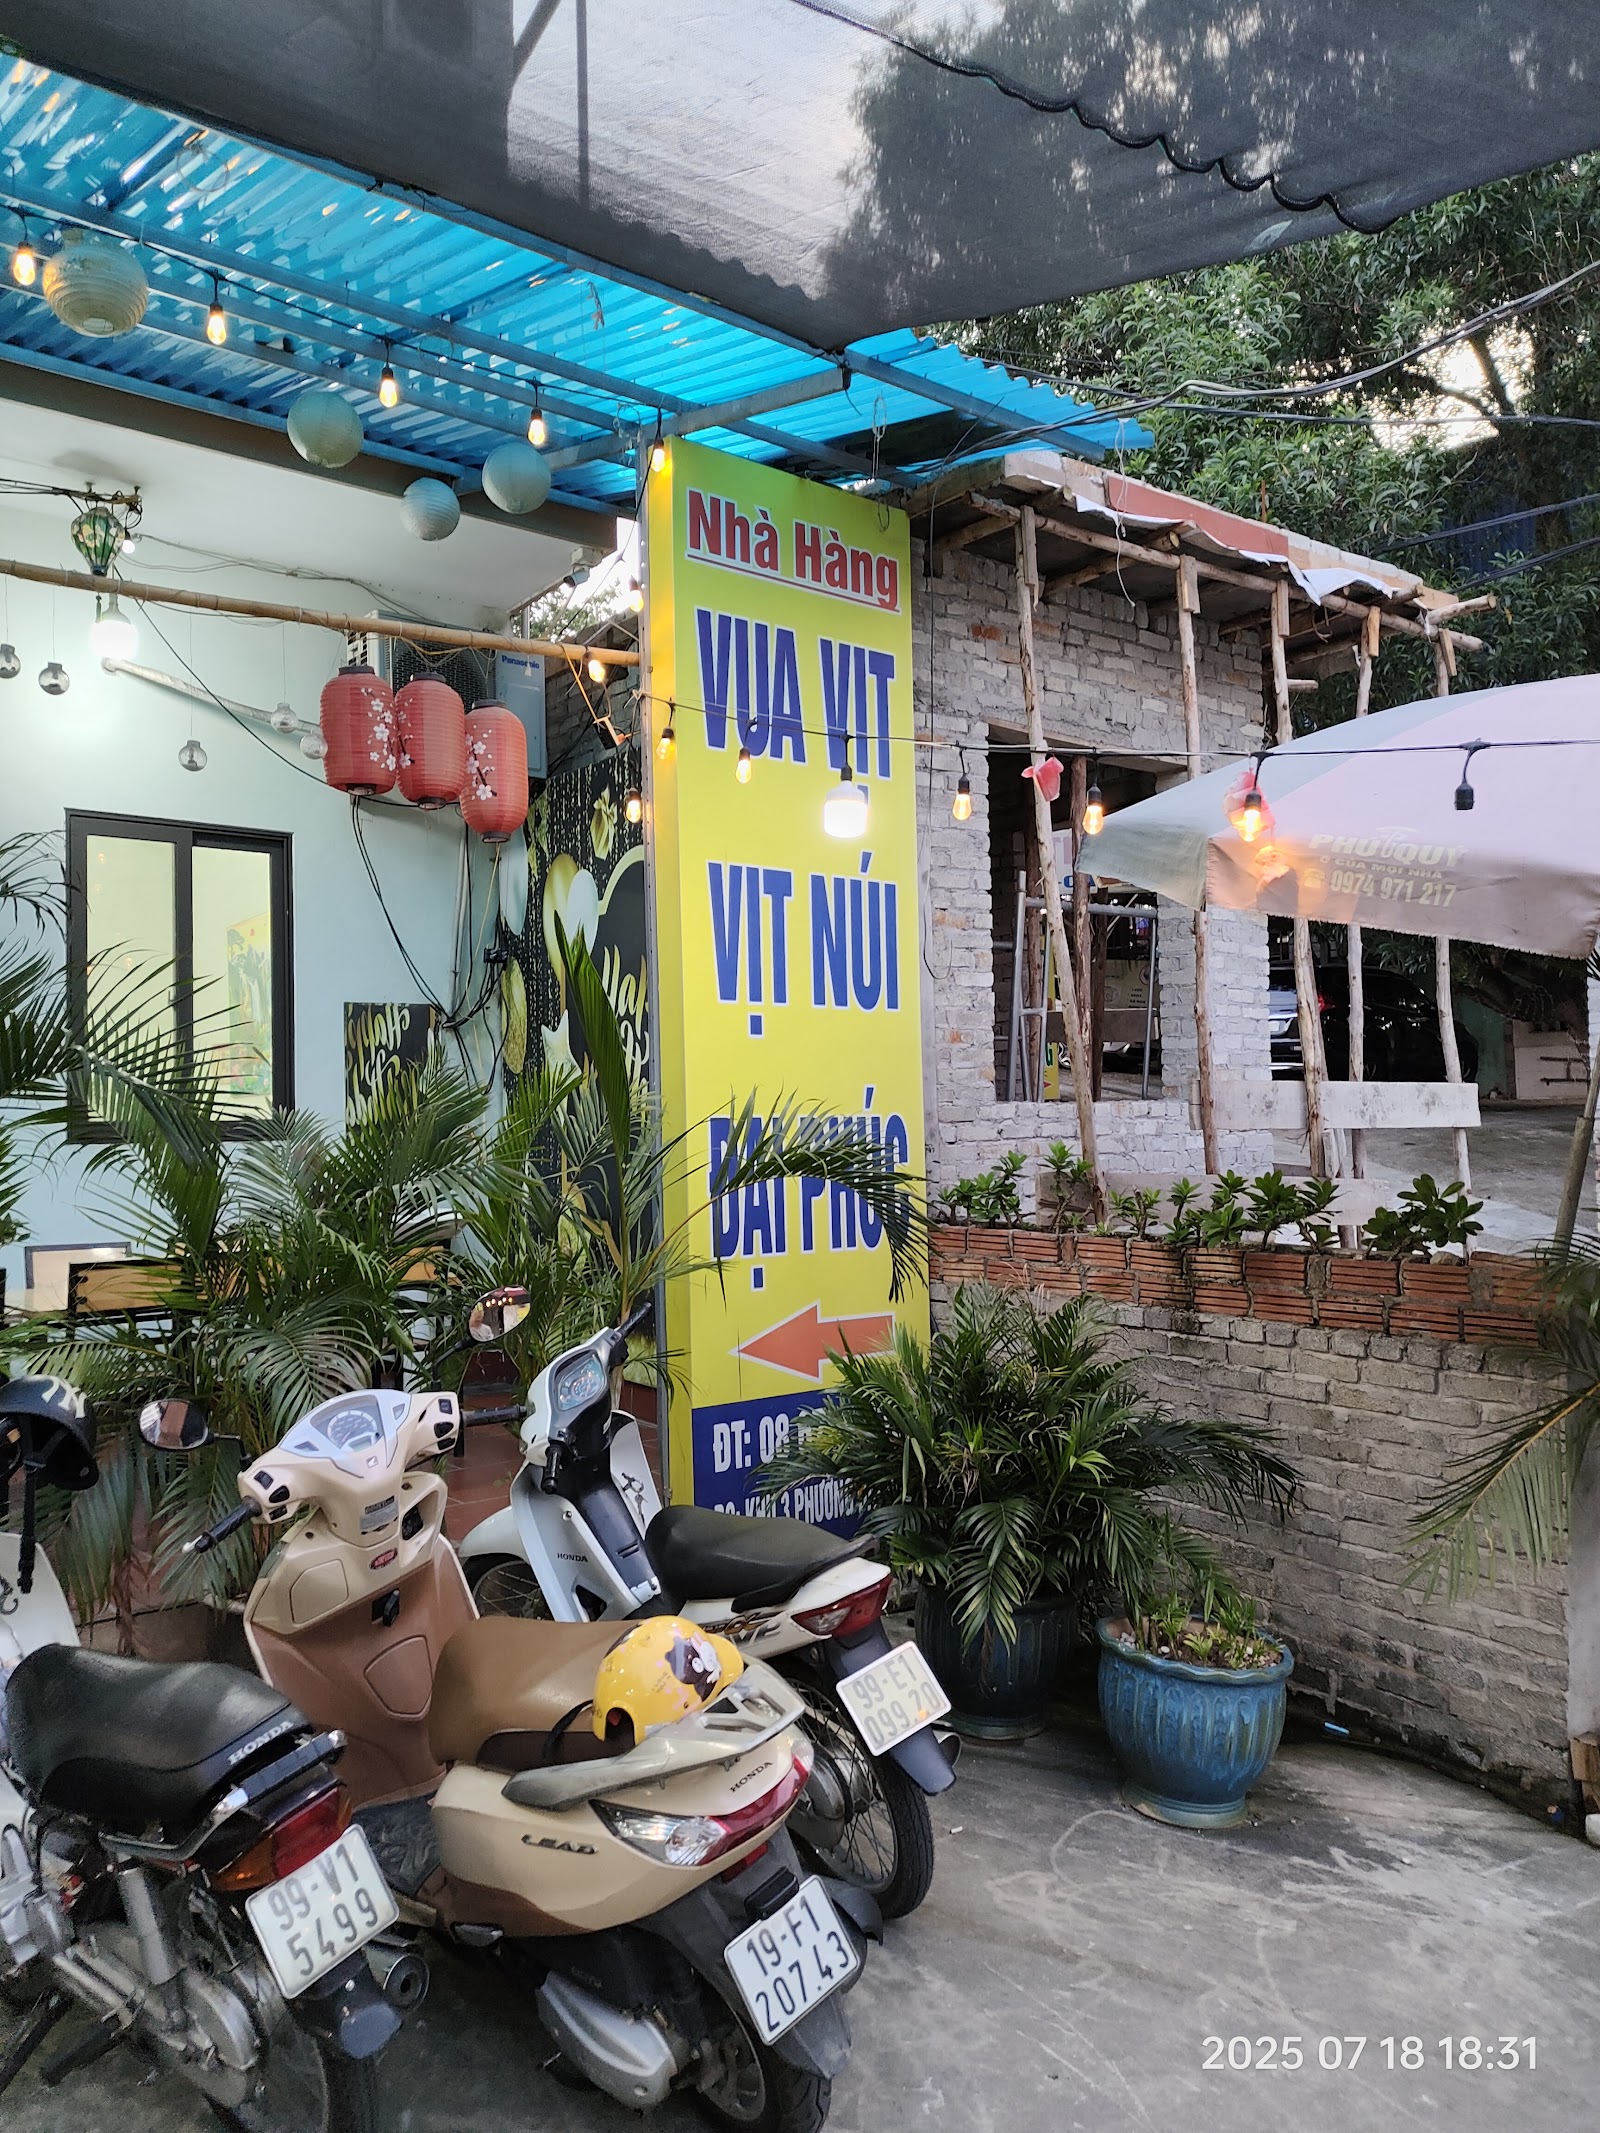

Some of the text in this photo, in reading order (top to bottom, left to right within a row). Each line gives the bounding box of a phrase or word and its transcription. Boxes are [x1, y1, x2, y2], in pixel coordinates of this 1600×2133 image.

[687, 489, 899, 611] Nhà Hàng
[696, 608, 807, 764] VUA
[1330, 870, 1457, 908] 0974 971 217
[707, 851, 899, 1036] VỊT NÚI
[712, 1419, 751, 1474] ĐT:
[556, 1552, 589, 1563] HONDA
[227, 1720, 295, 1766] HONDA
[729, 1761, 774, 1793] HONDA
[520, 1834, 600, 1856] LEAD
[267, 1843, 360, 1931] 99-V1
[286, 1887, 378, 1976] 5499
[755, 1930, 850, 2033] 207.43
